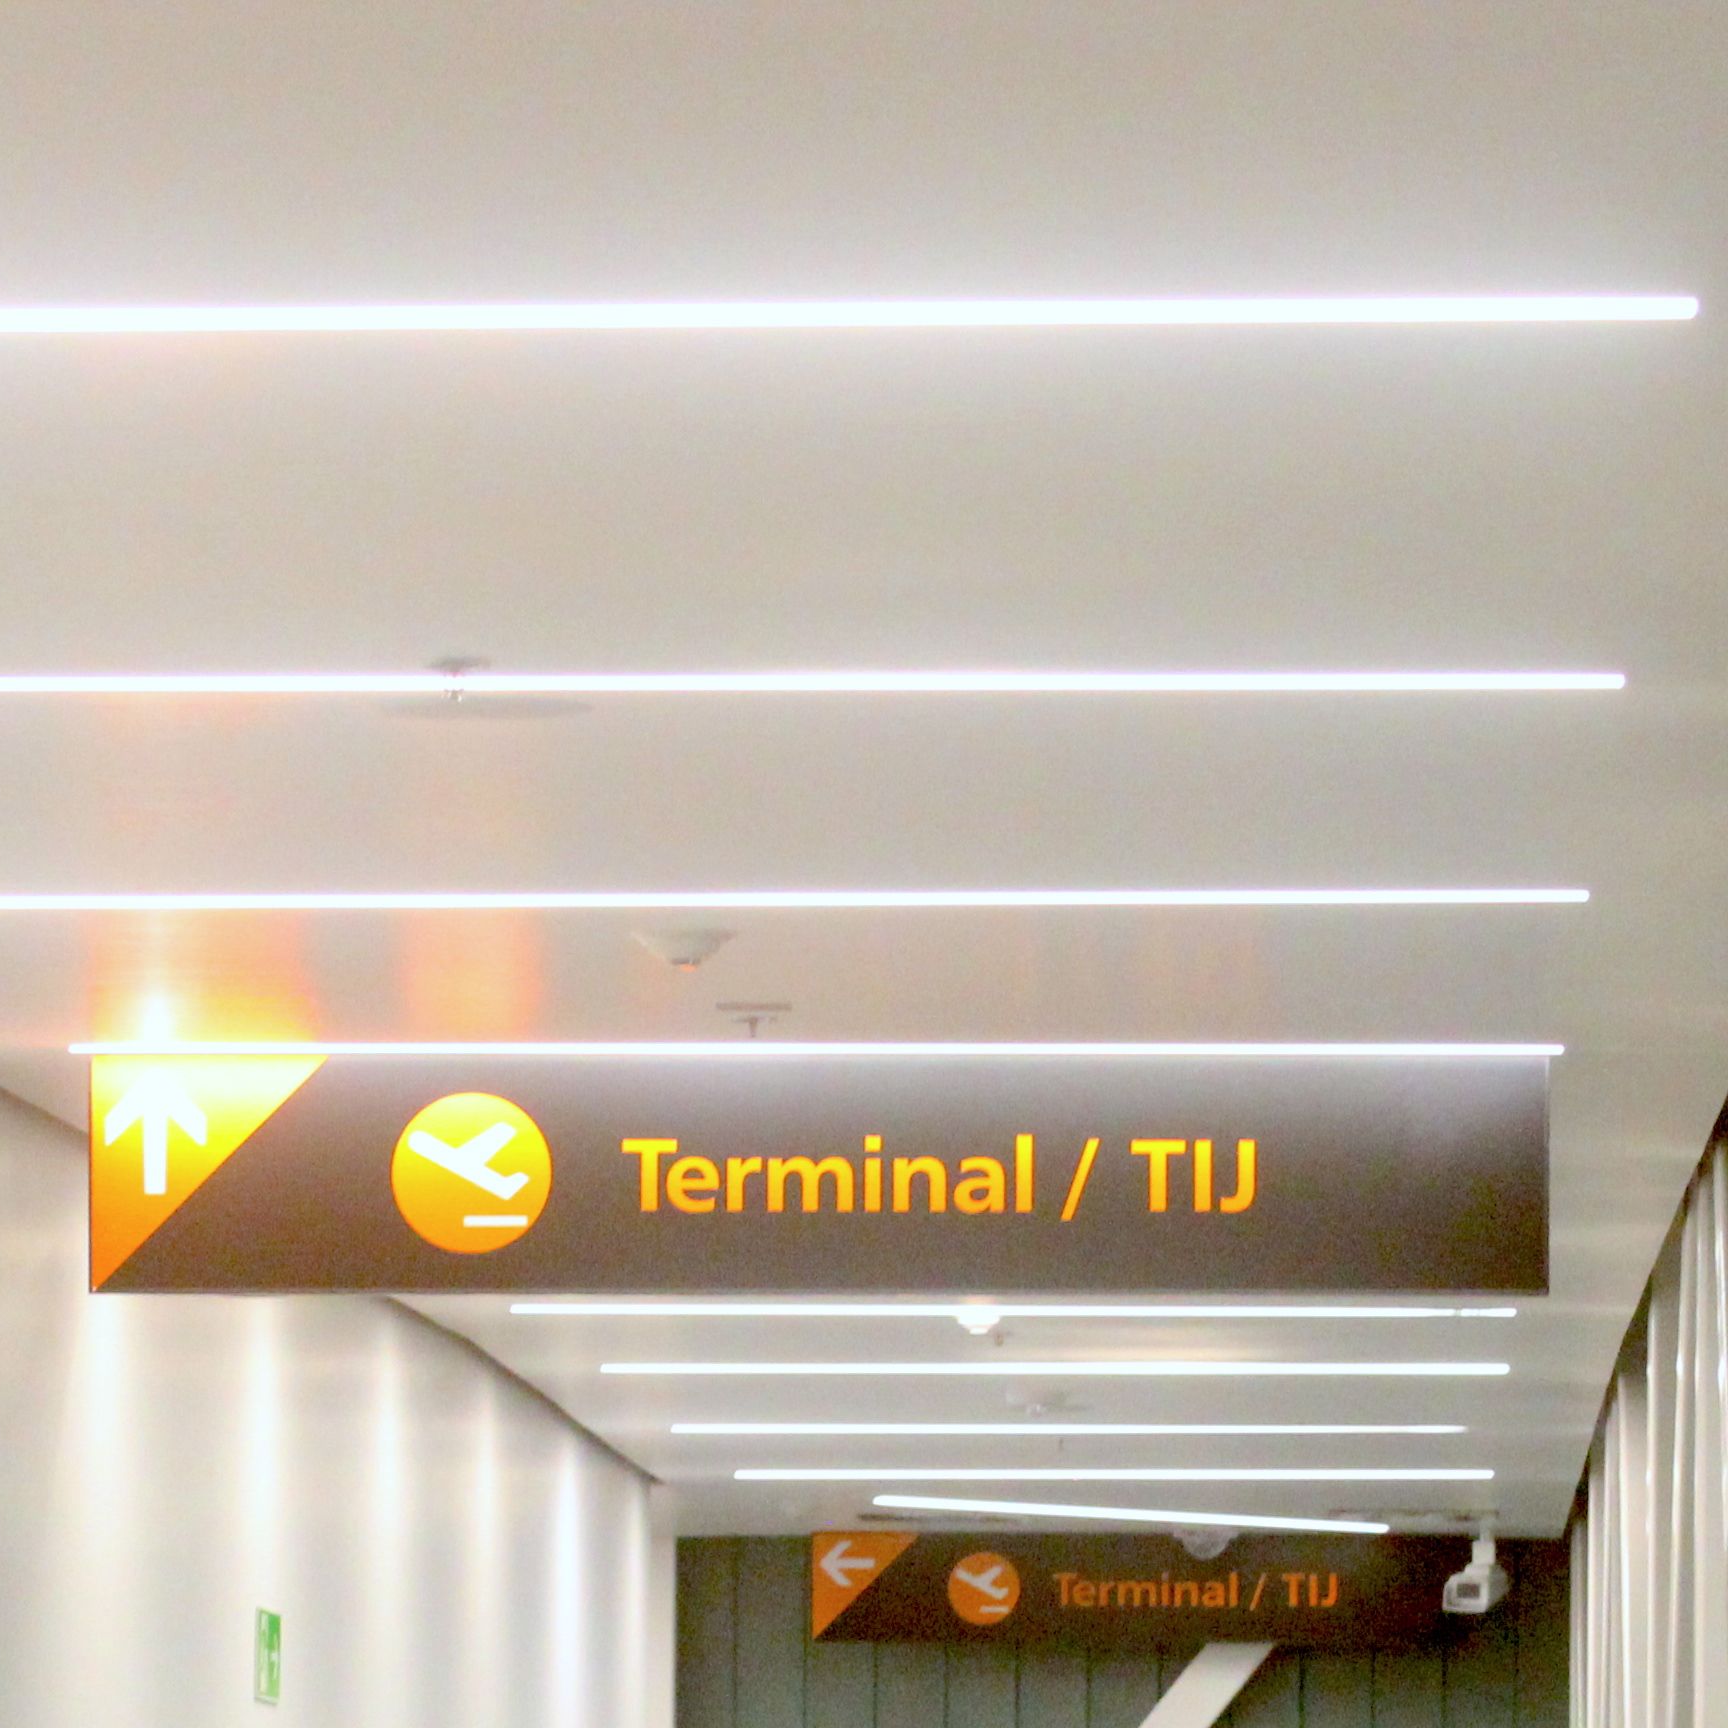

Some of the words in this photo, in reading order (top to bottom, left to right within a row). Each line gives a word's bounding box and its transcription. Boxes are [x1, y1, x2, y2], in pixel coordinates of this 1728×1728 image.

[619, 1133, 1036, 1214] Terminal
[1059, 1137, 1101, 1222] /
[1128, 1137, 1258, 1214] TIJ
[1053, 1571, 1240, 1608] Terminal
[1249, 1572, 1268, 1612] /
[1282, 1571, 1339, 1608] TIJ
